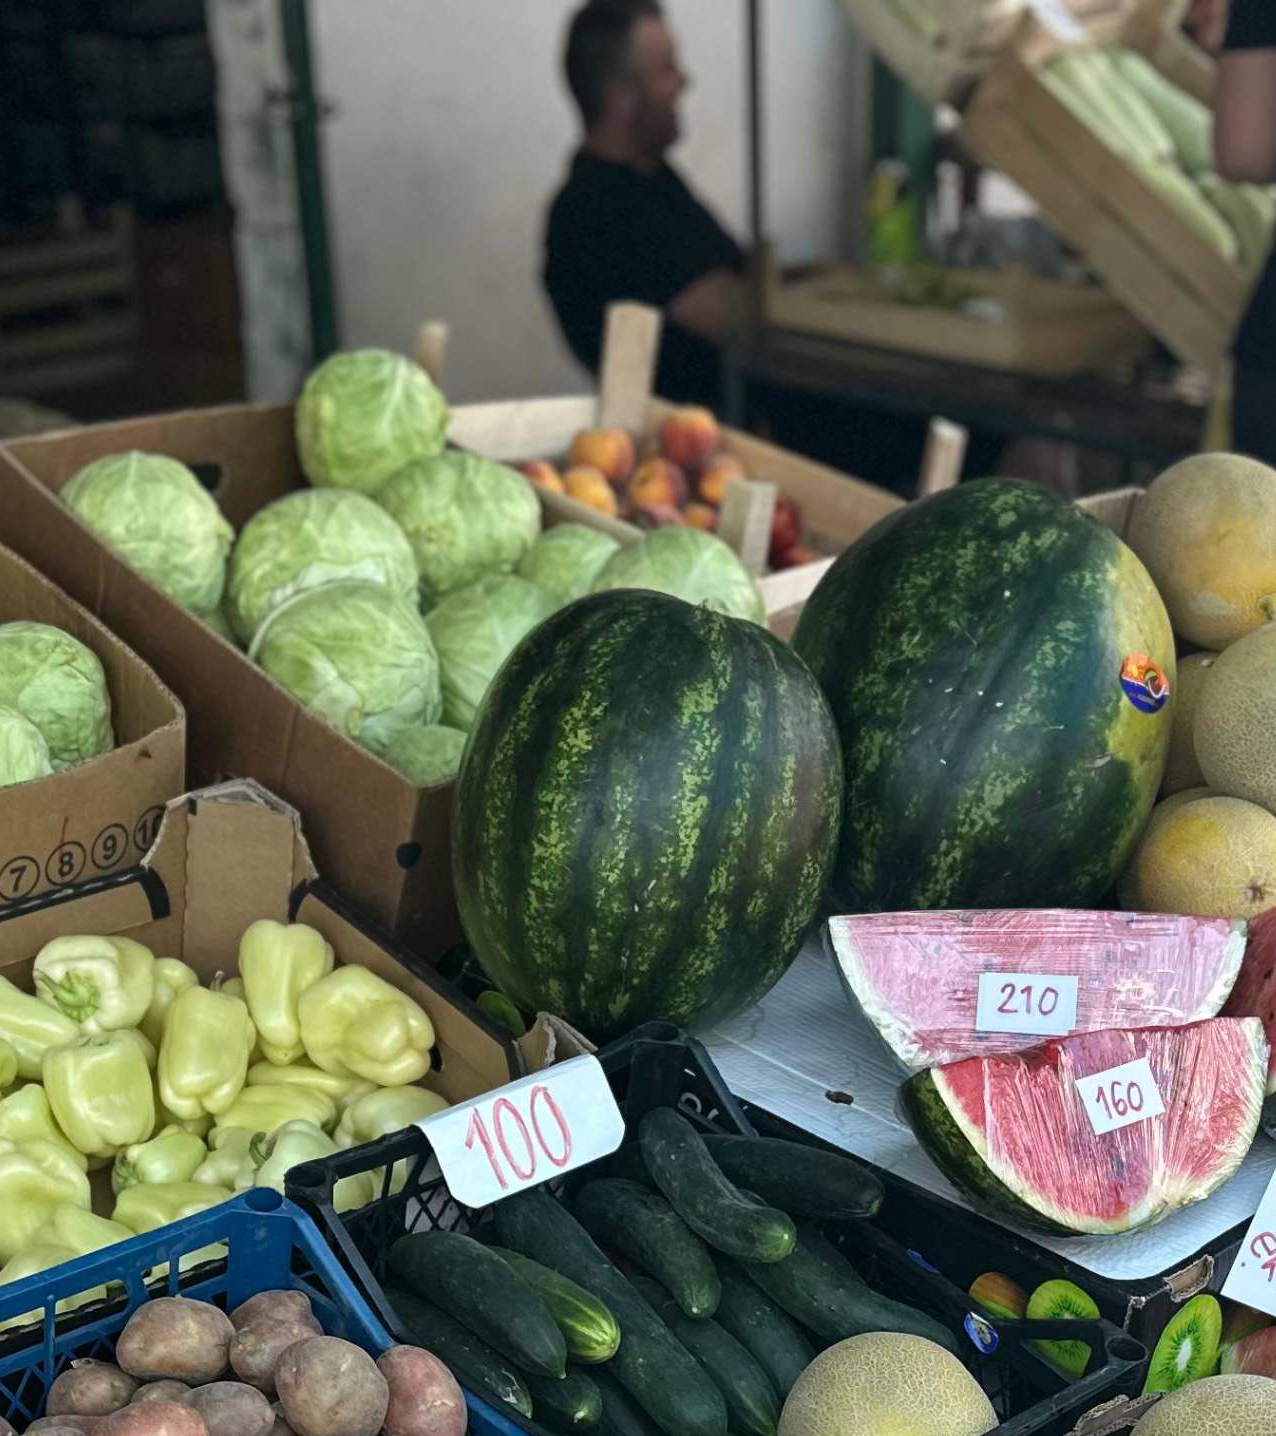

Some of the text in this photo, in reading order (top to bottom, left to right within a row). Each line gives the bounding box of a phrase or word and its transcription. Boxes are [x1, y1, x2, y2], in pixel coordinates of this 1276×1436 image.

[9, 866, 28, 893] 7
[58, 851, 76, 878] 8
[103, 834, 118, 860] 9
[996, 983, 1060, 1016] 210
[1095, 1081, 1145, 1120] 160
[465, 1085, 572, 1190] 100
